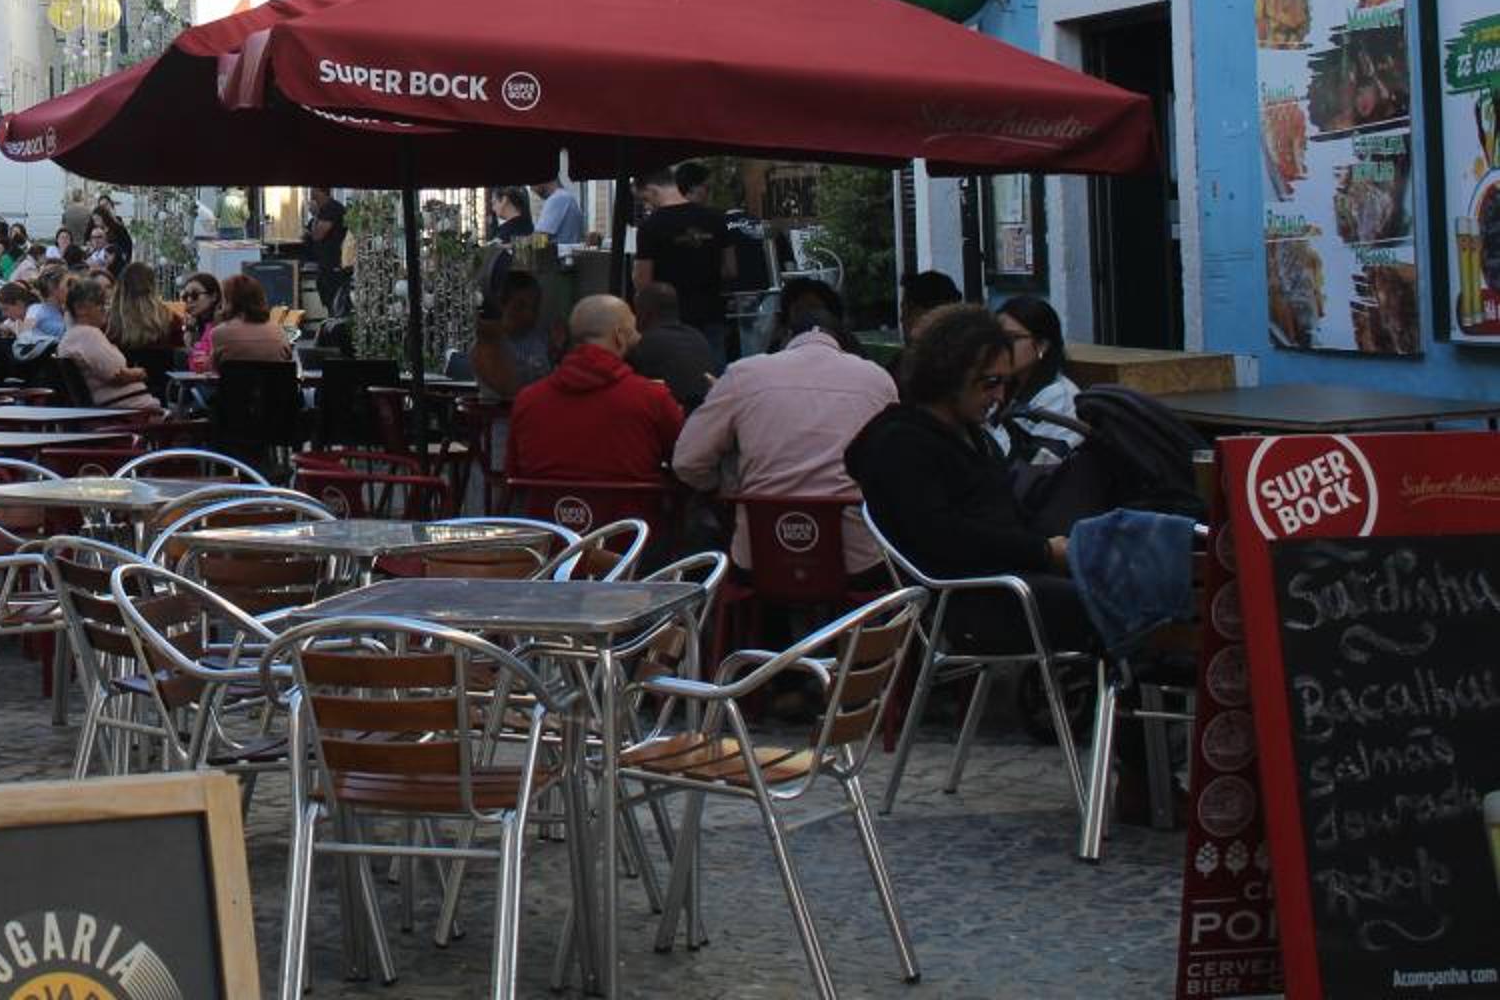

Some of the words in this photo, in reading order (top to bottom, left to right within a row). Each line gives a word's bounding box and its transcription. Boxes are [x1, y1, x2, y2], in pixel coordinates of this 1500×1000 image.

[319, 59, 403, 94] SUPER
[409, 71, 489, 101] BOCK
[1260, 449, 1352, 511] SUPER
[1276, 480, 1363, 537] BOCK
